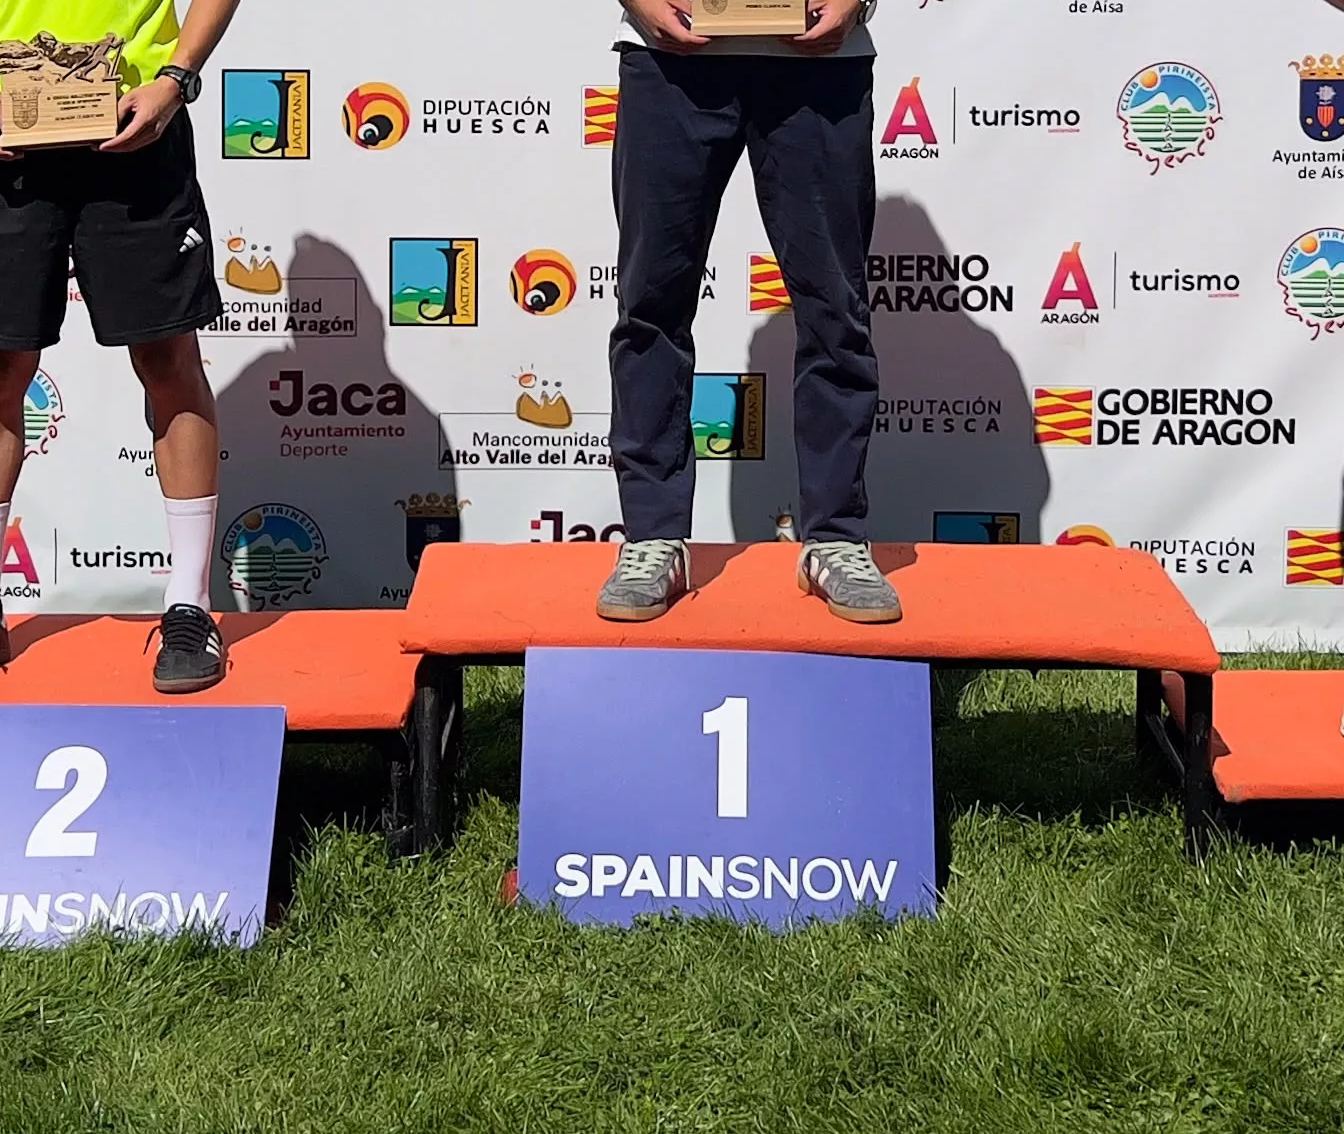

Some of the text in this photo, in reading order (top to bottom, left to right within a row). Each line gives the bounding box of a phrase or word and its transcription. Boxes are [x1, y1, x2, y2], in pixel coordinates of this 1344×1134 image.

[1068, 0, 1124, 14] de Aísa
[1120, 65, 1216, 111] CLUB PIRINEISTA
[422, 95, 551, 116] DIPUTACIÓN
[969, 103, 1081, 127] turismo
[422, 118, 551, 135] HUESCA
[879, 145, 939, 159] ARAGÓN
[1298, 165, 1317, 179] de
[866, 254, 989, 282] BIERNO
[1281, 247, 1299, 276] CLUB
[1129, 268, 1240, 292] turismo
[222, 297, 322, 314] comunidad
[869, 285, 1014, 312] ARAGON
[199, 315, 355, 335] alle del Aragón
[1040, 310, 1100, 324] ARAGÓN
[269, 369, 406, 417] Jaca
[1097, 387, 1273, 416] GOBIERNO
[875, 396, 1002, 415] DIPUTACIÓN
[280, 423, 406, 441] Ayuntamiento
[875, 417, 1000, 433] HUESCA
[1096, 417, 1296, 446] DE ARAGON
[280, 442, 349, 460] Deporte
[440, 449, 480, 465] Alto
[485, 449, 532, 465] Valle
[537, 449, 566, 465] del
[702, 696, 748, 818] 1
[25, 744, 108, 857] 2
[554, 853, 898, 902] SPAINSNOW
